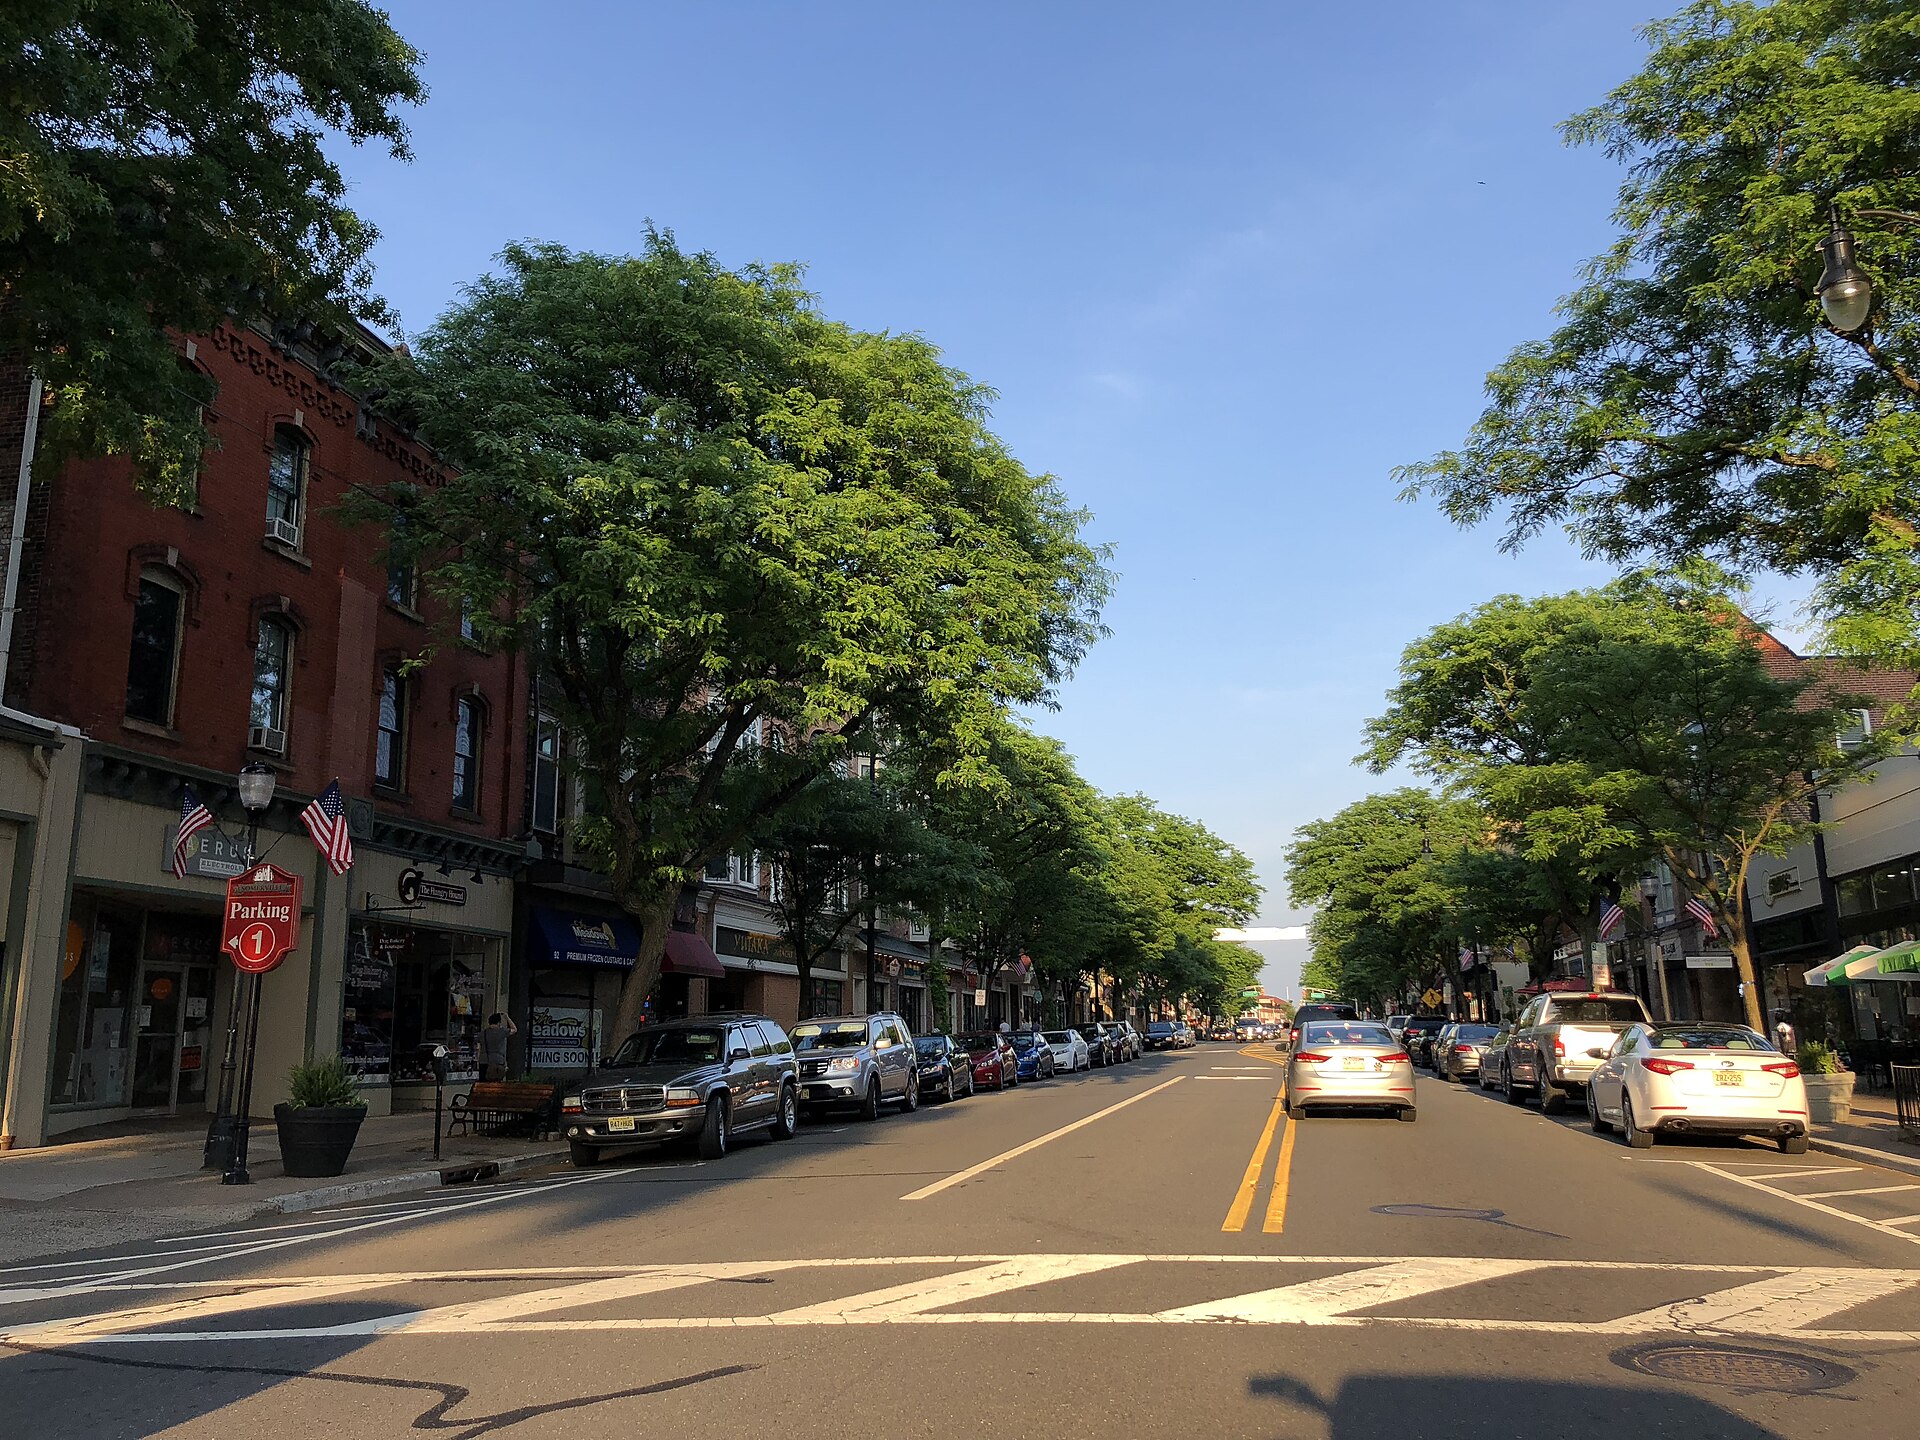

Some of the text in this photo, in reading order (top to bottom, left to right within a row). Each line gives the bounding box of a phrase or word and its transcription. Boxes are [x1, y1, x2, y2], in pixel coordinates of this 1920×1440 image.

[241, 884, 284, 892] SOMERVILLE
[421, 885, 464, 900] The Hungry Hound
[229, 901, 290, 923] Parking
[572, 926, 609, 941] Meadows
[251, 930, 263, 955] 1
[734, 933, 769, 954] YUTAKA
[553, 950, 560, 960] 92
[566, 951, 587, 961] PREMIUM
[587, 953, 604, 963] FROZEN
[603, 955, 623, 965] CUSTARD
[532, 1023, 586, 1038] eadows
[532, 1051, 561, 1064] MING
